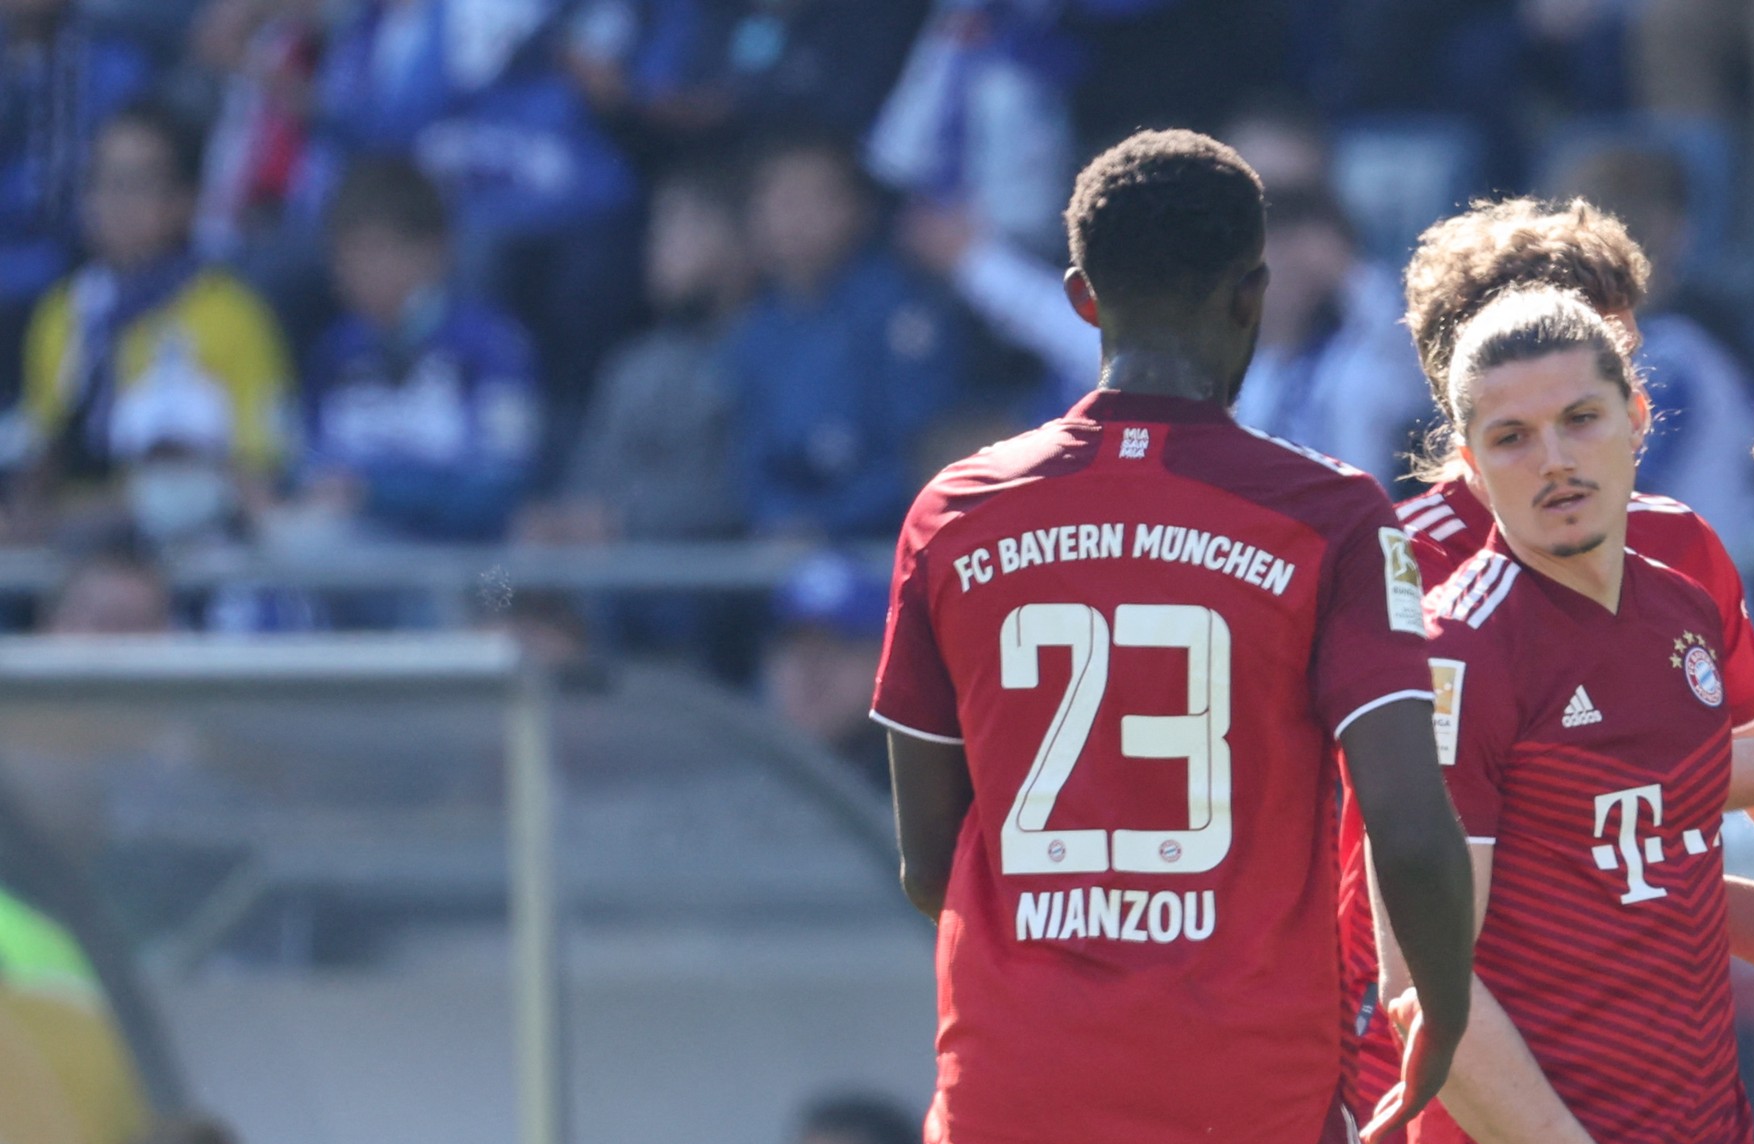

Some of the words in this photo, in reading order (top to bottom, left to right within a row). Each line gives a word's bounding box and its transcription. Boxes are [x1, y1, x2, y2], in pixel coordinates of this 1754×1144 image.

[953, 548, 994, 593] FC
[998, 523, 1124, 574] BAYERN
[1132, 523, 1295, 596] MÜNCHEN
[1001, 603, 1231, 875] 23
[1562, 709, 1602, 728] adidas
[1593, 784, 1668, 905] T
[1016, 886, 1216, 944] NIANZOU
